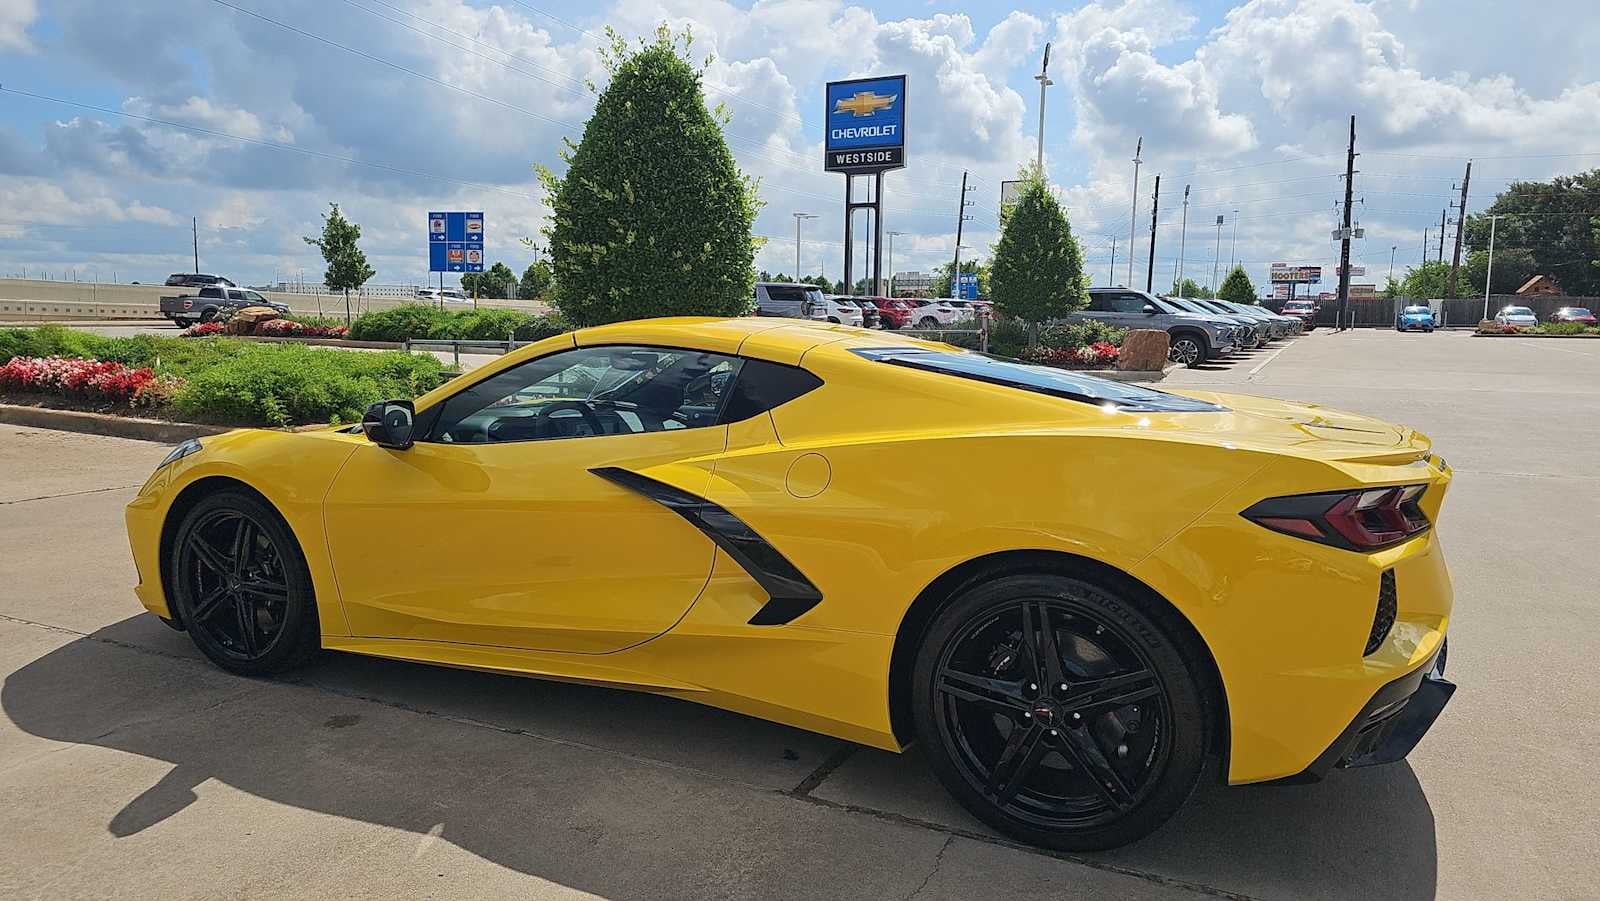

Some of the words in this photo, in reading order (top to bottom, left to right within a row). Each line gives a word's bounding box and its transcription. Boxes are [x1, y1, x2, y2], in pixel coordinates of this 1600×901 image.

[832, 125, 896, 139] CHEVROLET
[836, 151, 892, 164] WESTSIDE
[1272, 272, 1309, 280] HOOTERS
